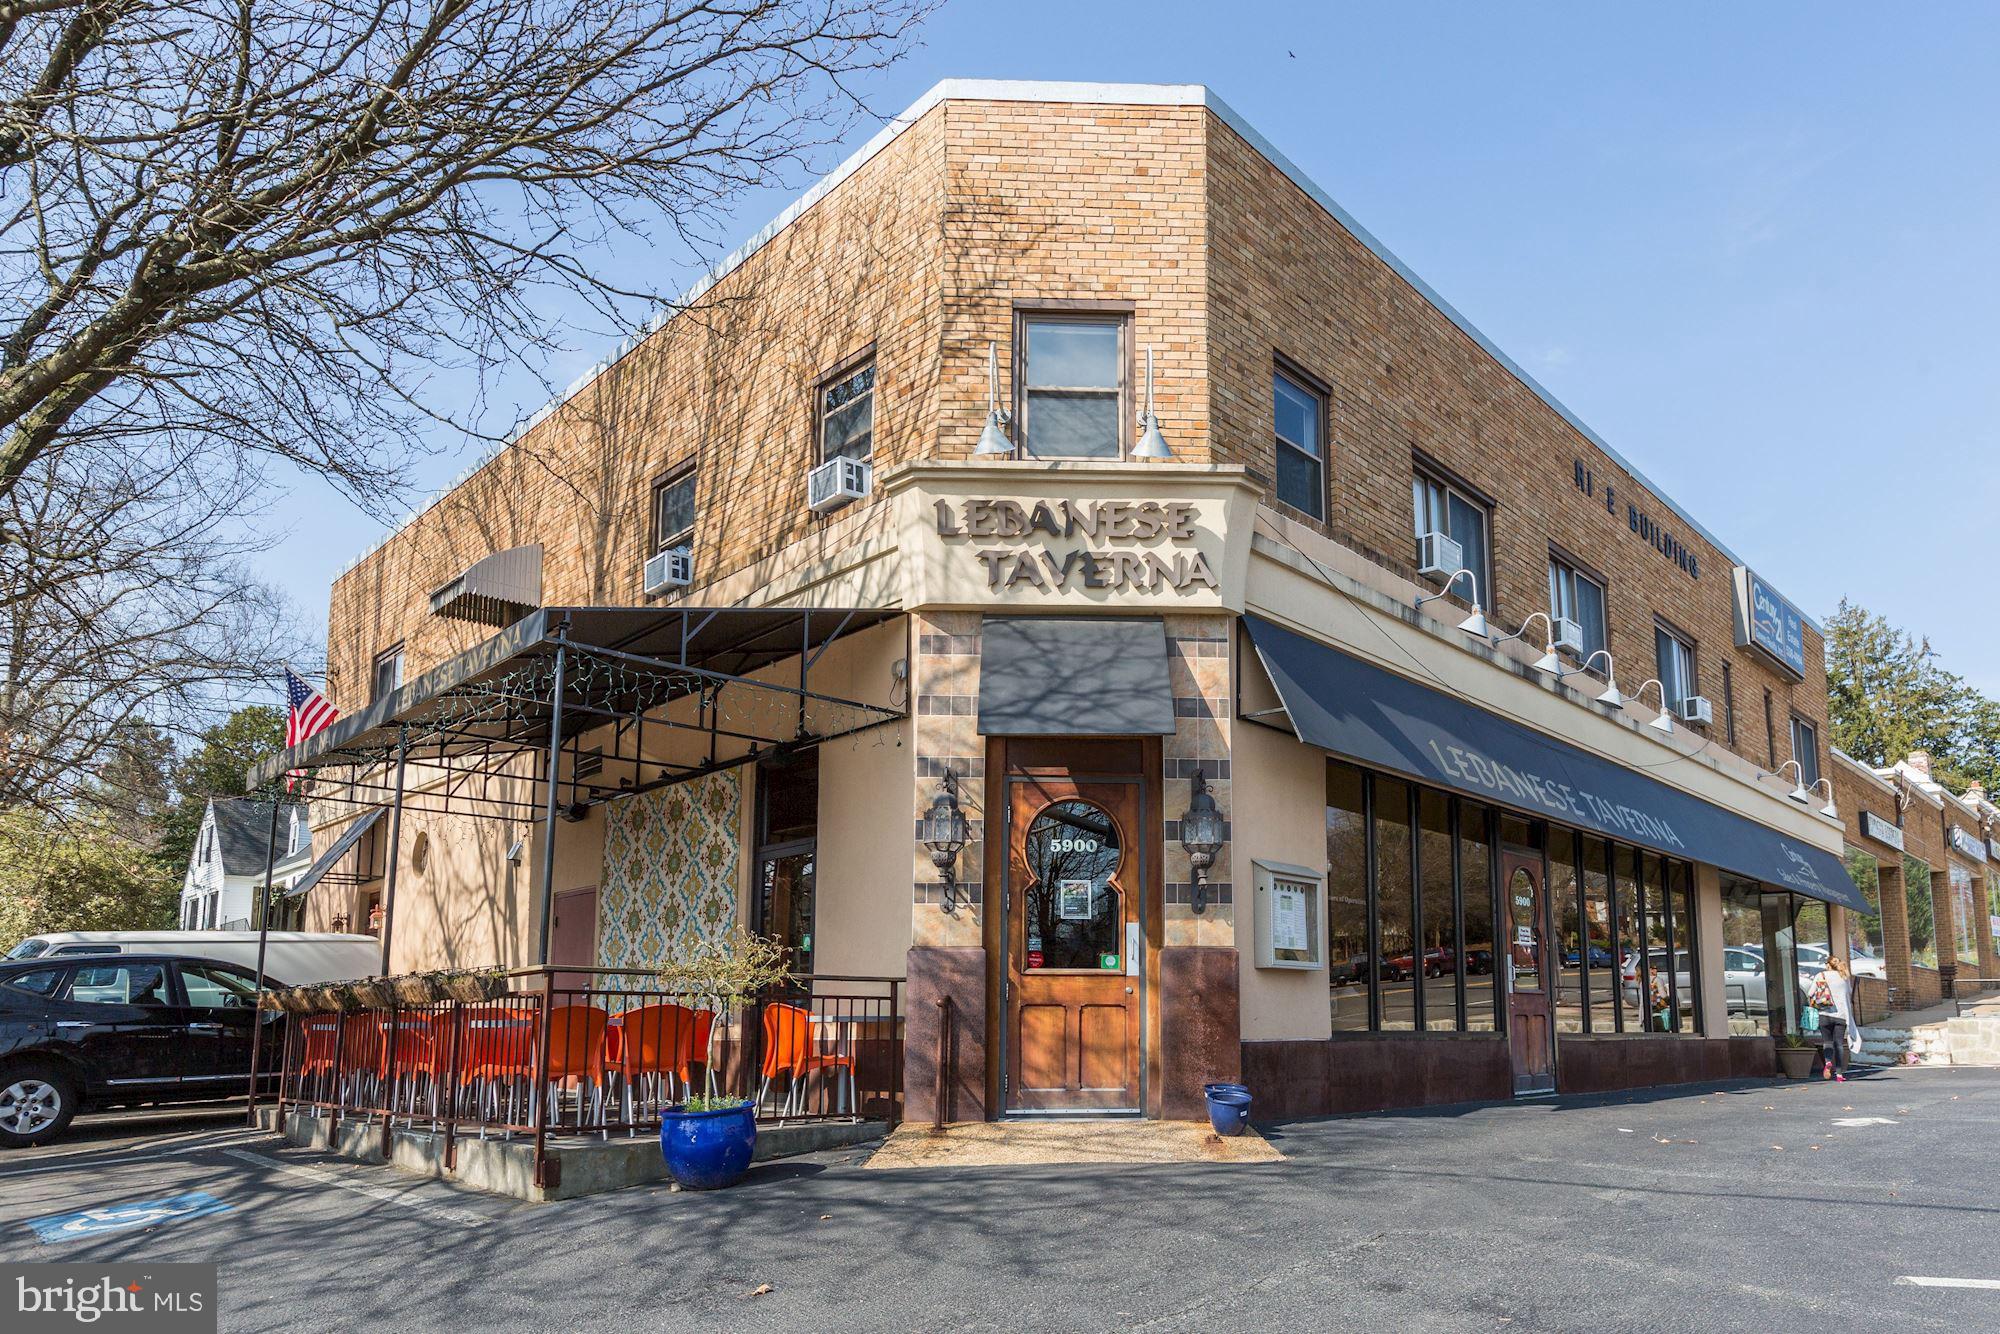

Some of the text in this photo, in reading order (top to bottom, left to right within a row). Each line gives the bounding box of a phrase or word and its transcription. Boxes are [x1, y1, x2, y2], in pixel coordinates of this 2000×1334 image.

[933, 499, 1195, 539] LEBANESE
[1628, 505, 1698, 580] BUILDING
[975, 549, 1220, 589] TAVERNA
[395, 660, 455, 712] LEBANESE
[1428, 739, 1686, 849] LEBANESE TAVERNA
[1050, 839, 1098, 853] 5900
[1515, 895, 1531, 907] 5900
